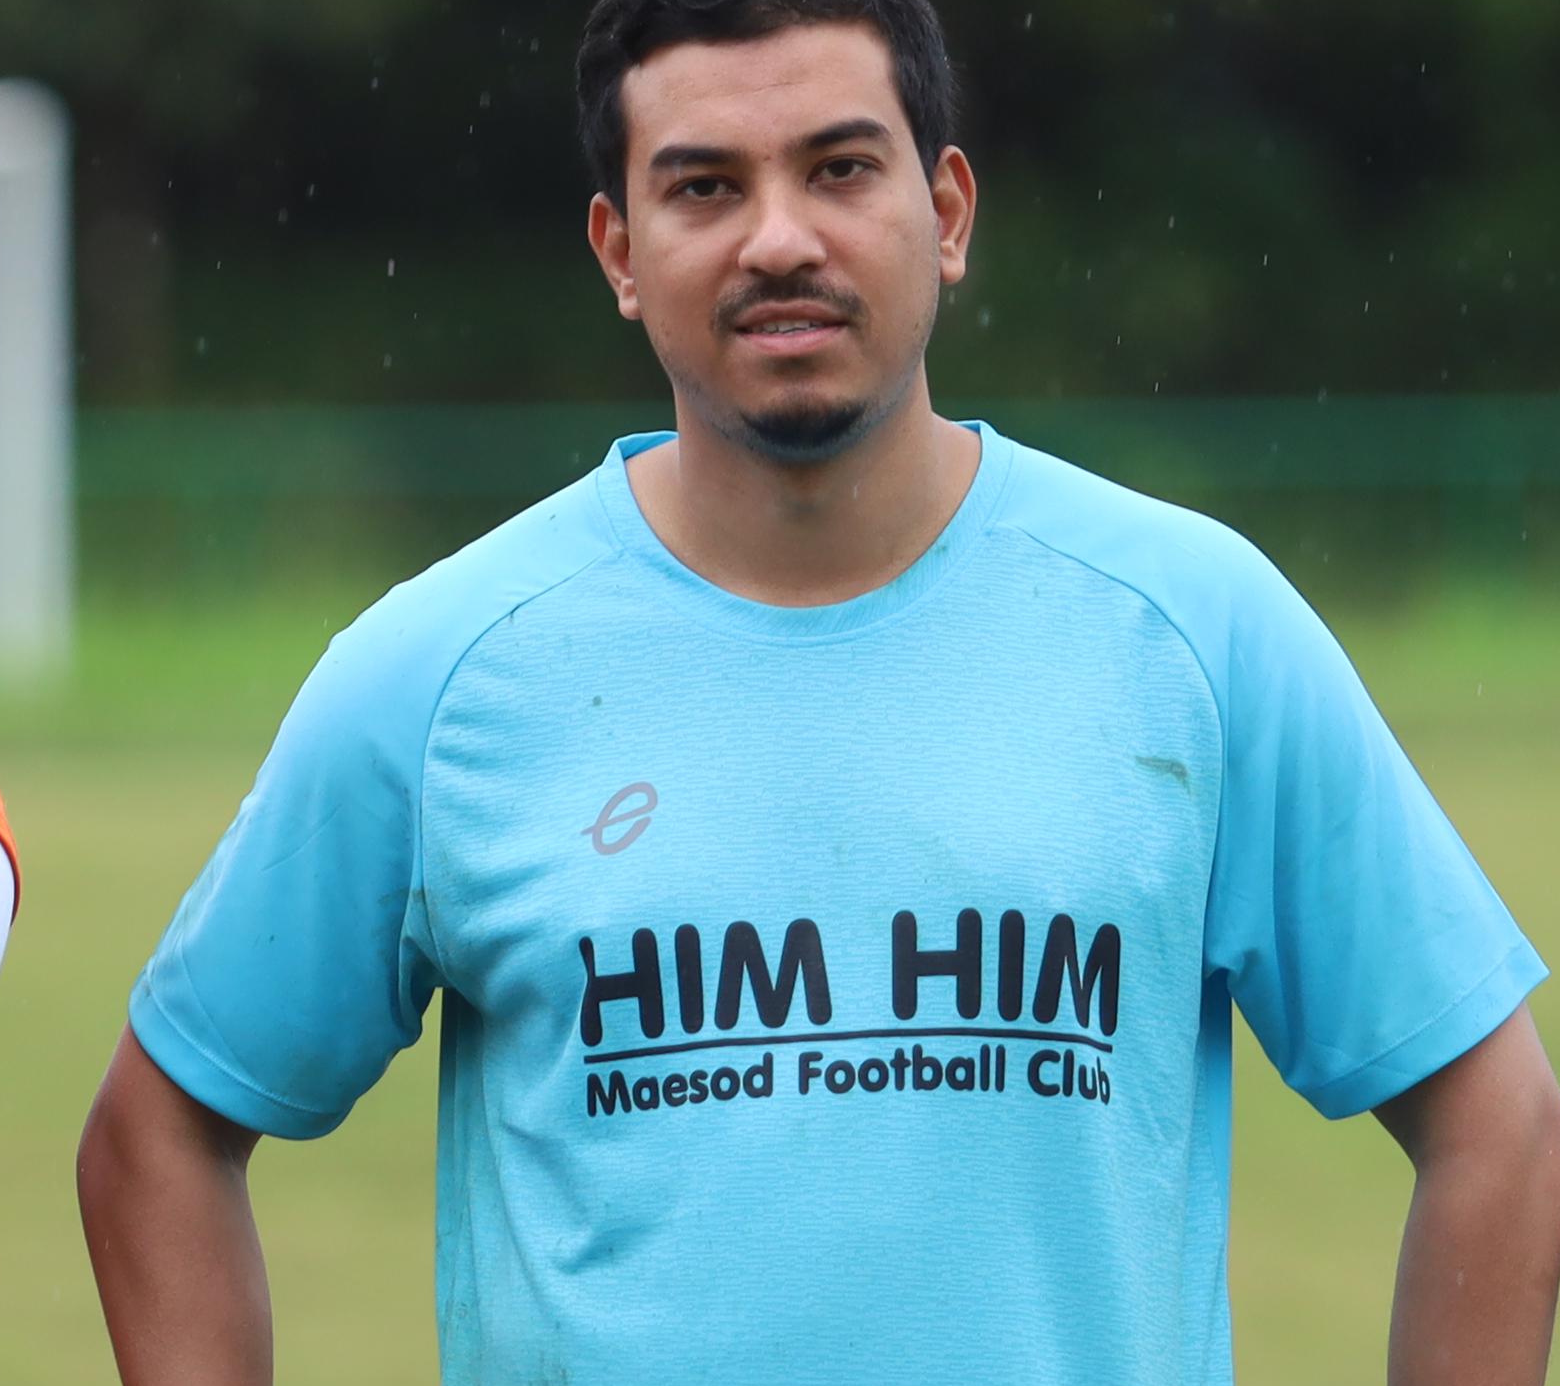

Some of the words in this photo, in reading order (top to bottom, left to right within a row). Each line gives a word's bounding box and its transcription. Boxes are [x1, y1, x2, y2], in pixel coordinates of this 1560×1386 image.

[579, 916, 833, 1048] HIM
[891, 907, 1122, 1037] HIM
[586, 1050, 774, 1118] Maesod
[797, 1043, 1007, 1097] Football
[1026, 1048, 1111, 1106] Club
